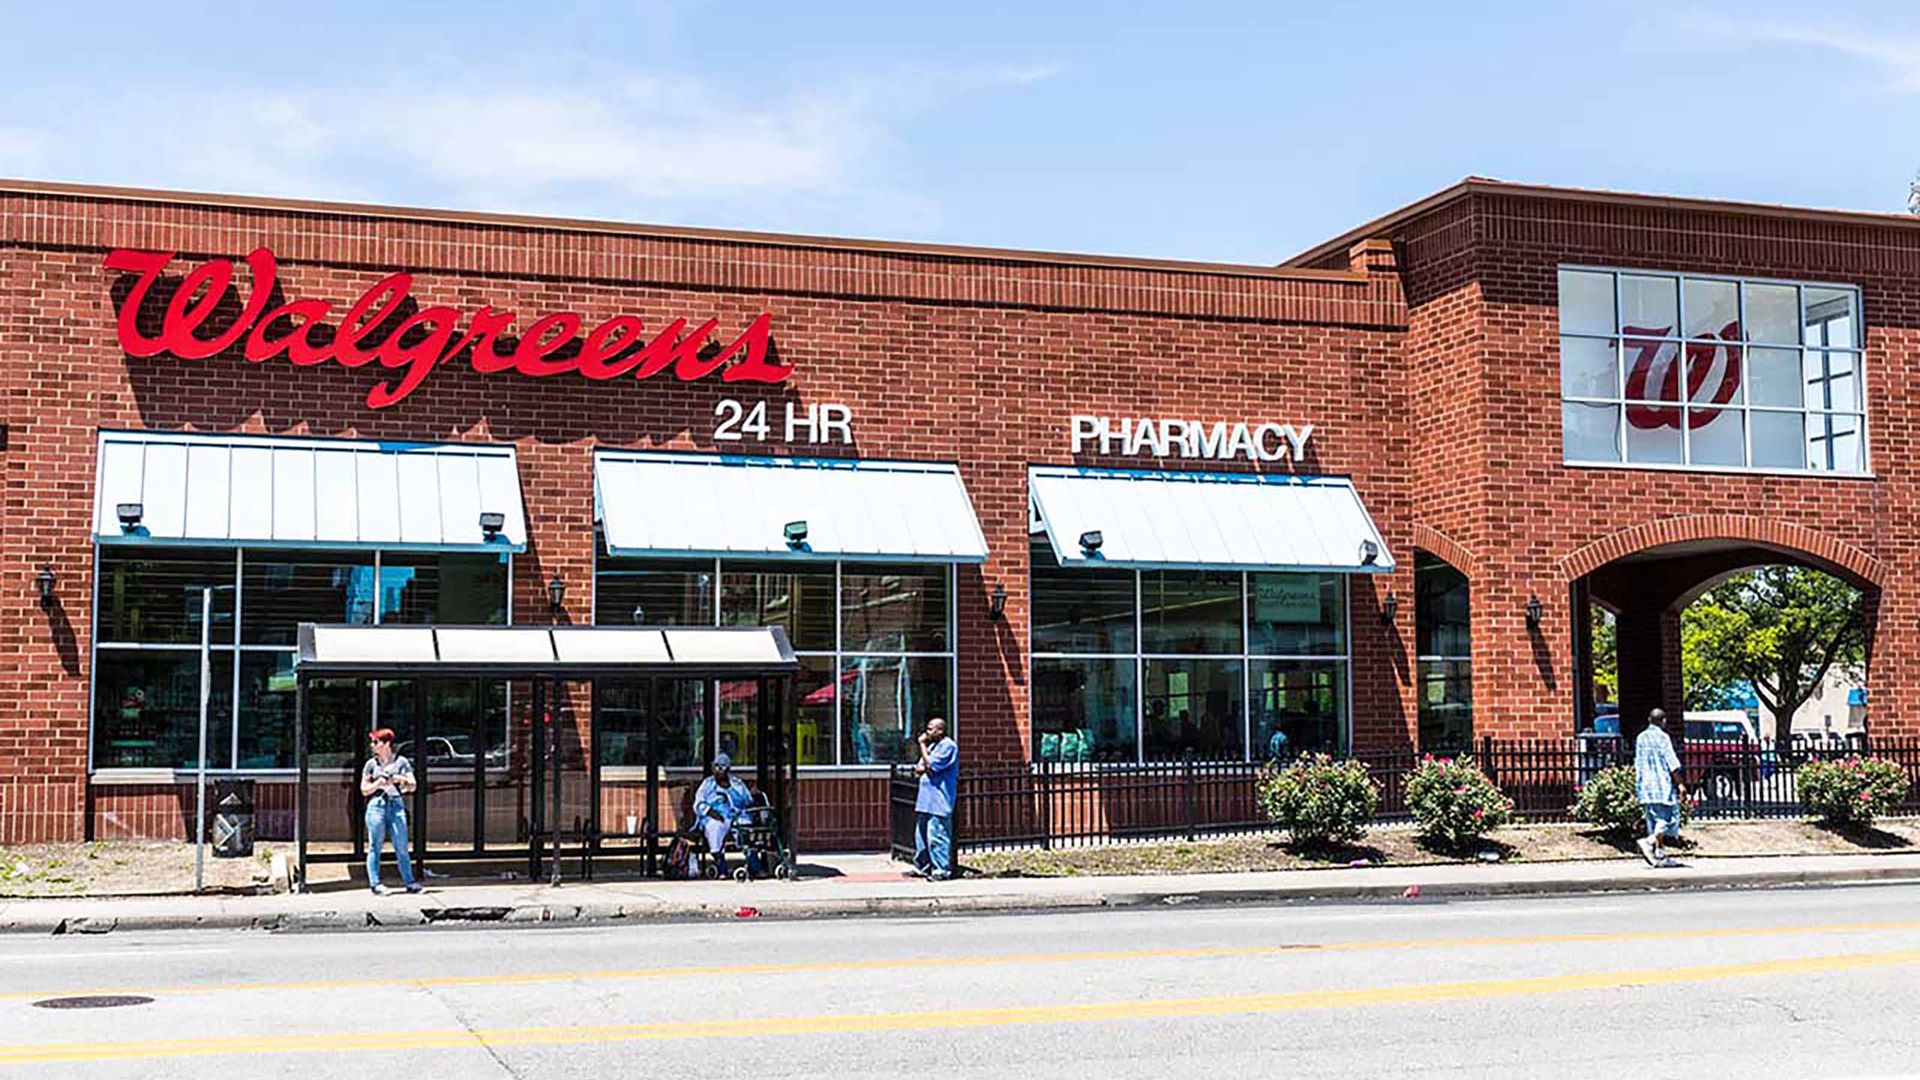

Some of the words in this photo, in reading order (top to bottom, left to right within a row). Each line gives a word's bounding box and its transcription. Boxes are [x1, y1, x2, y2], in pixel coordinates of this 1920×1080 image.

[103, 247, 793, 408] Walgreens
[713, 399, 771, 441] 24
[784, 402, 853, 444] HR
[1071, 415, 1315, 462] PHARMACY
